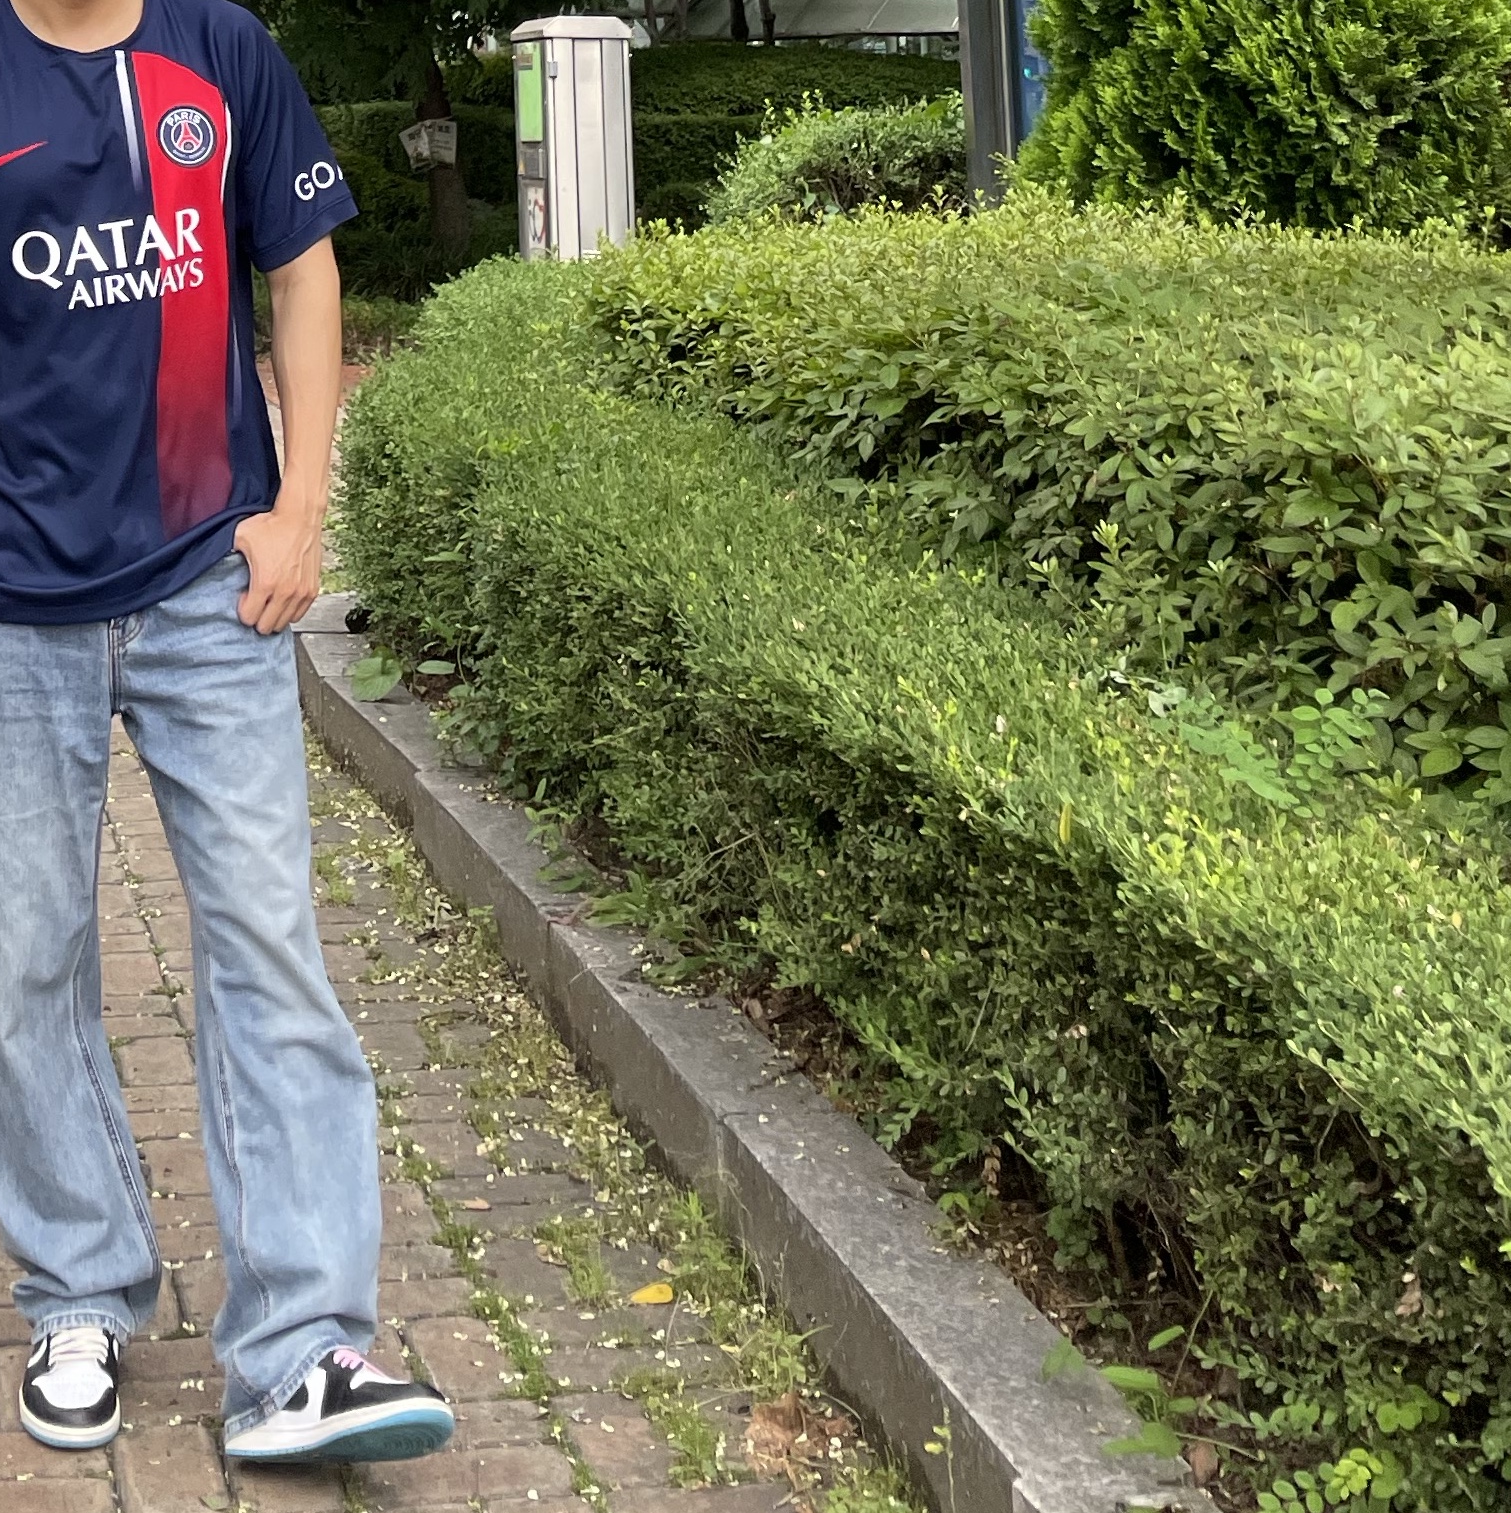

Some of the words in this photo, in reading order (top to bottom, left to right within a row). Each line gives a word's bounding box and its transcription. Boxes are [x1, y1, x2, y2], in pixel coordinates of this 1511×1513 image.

[166, 111, 201, 127] PARIS
[11, 207, 204, 290] QATAR
[68, 257, 204, 310] AIRWAYS
